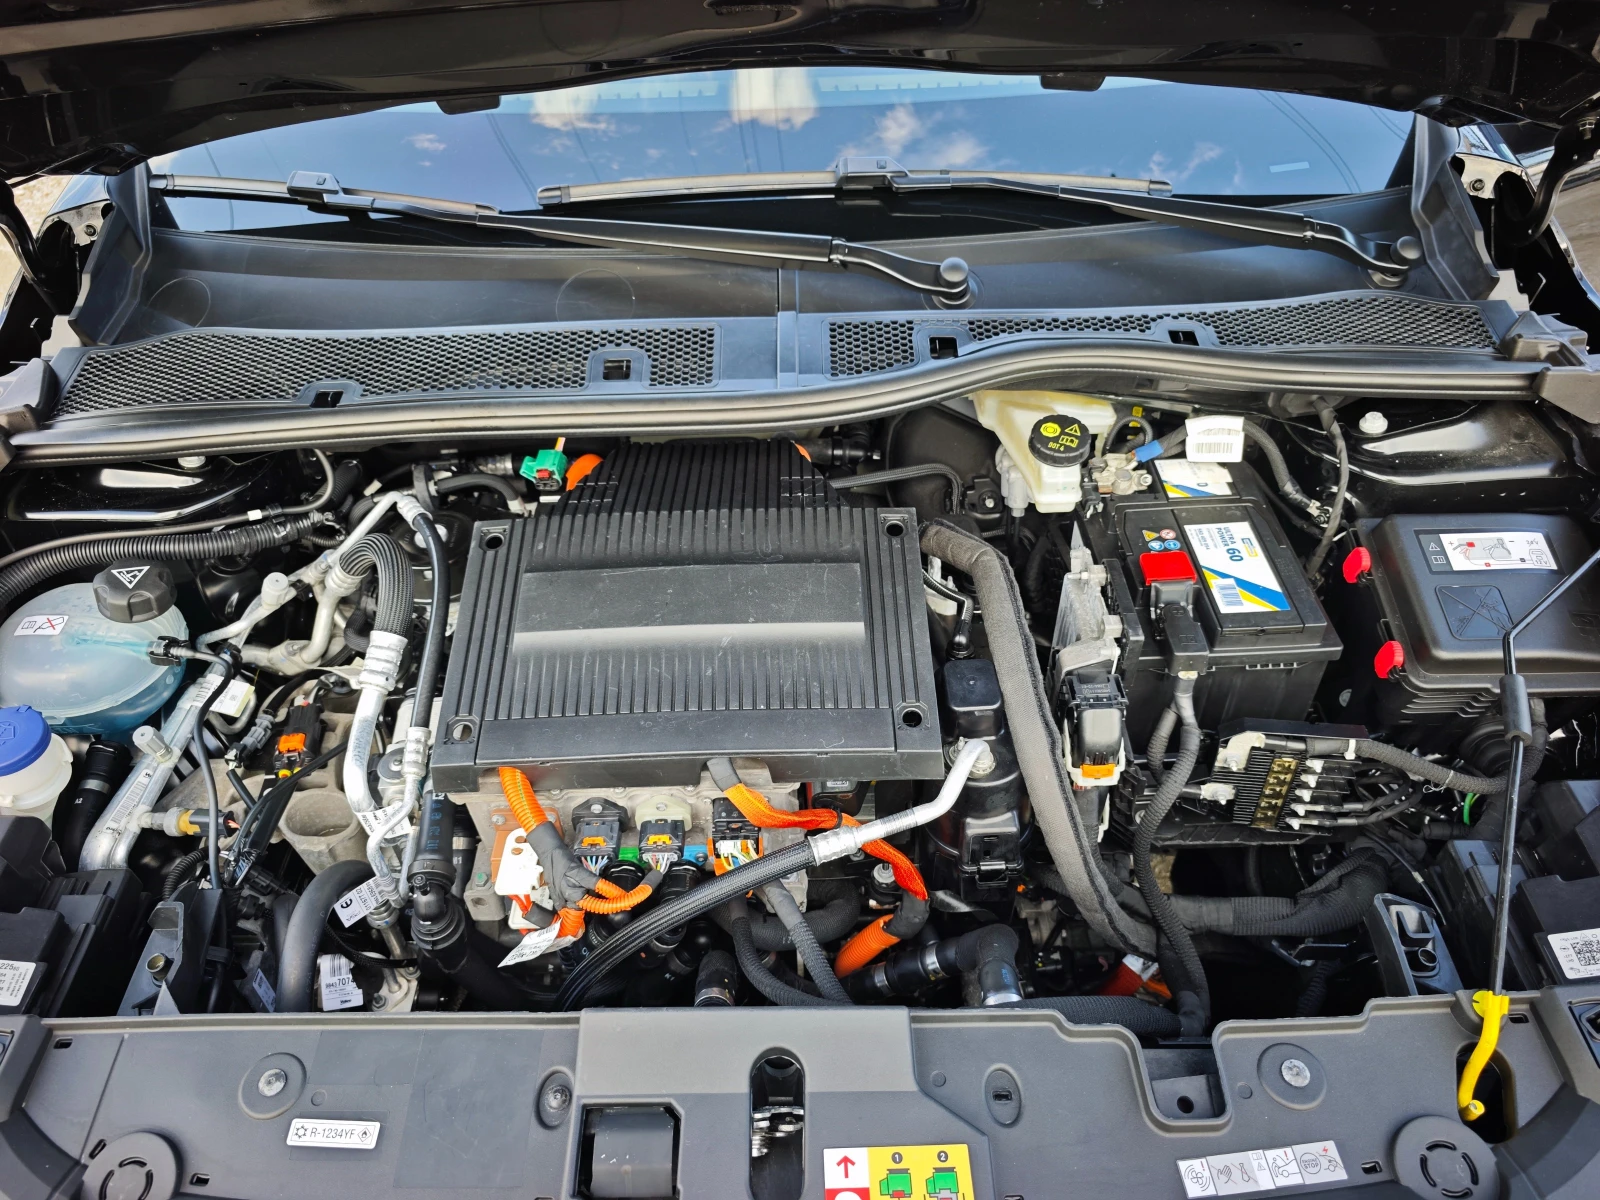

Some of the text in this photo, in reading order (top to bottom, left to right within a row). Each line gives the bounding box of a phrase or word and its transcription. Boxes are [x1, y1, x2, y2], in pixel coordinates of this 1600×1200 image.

[1048, 441, 1060, 449] DOT
[1215, 527, 1230, 547] POWER
[1223, 526, 1236, 544] ULTRA
[1226, 548, 1243, 561] 60
[310, 1127, 356, 1139] R-1234YF
